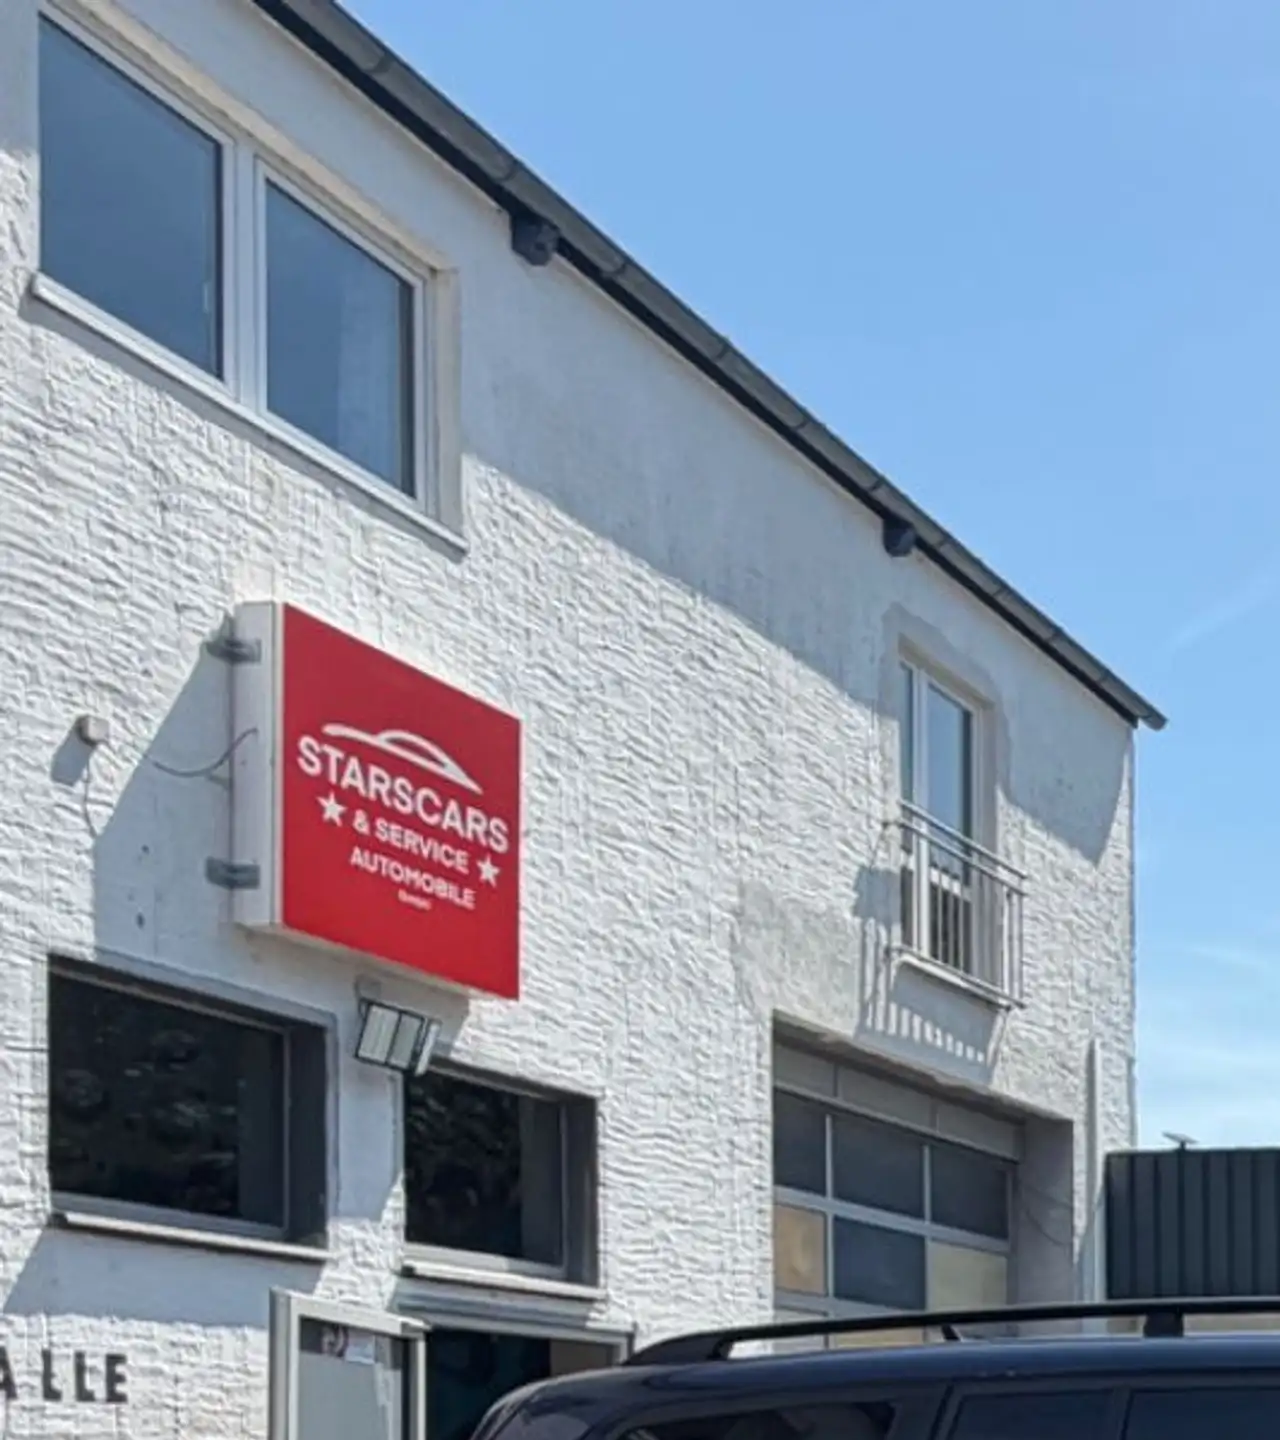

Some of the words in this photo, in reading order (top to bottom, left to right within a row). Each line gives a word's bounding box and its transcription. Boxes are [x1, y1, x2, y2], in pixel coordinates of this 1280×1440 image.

[297, 735, 509, 853] STARSCARS
[352, 809, 371, 835] &
[374, 818, 470, 874] SERVICE
[350, 846, 476, 910] AUTOMOBILE
